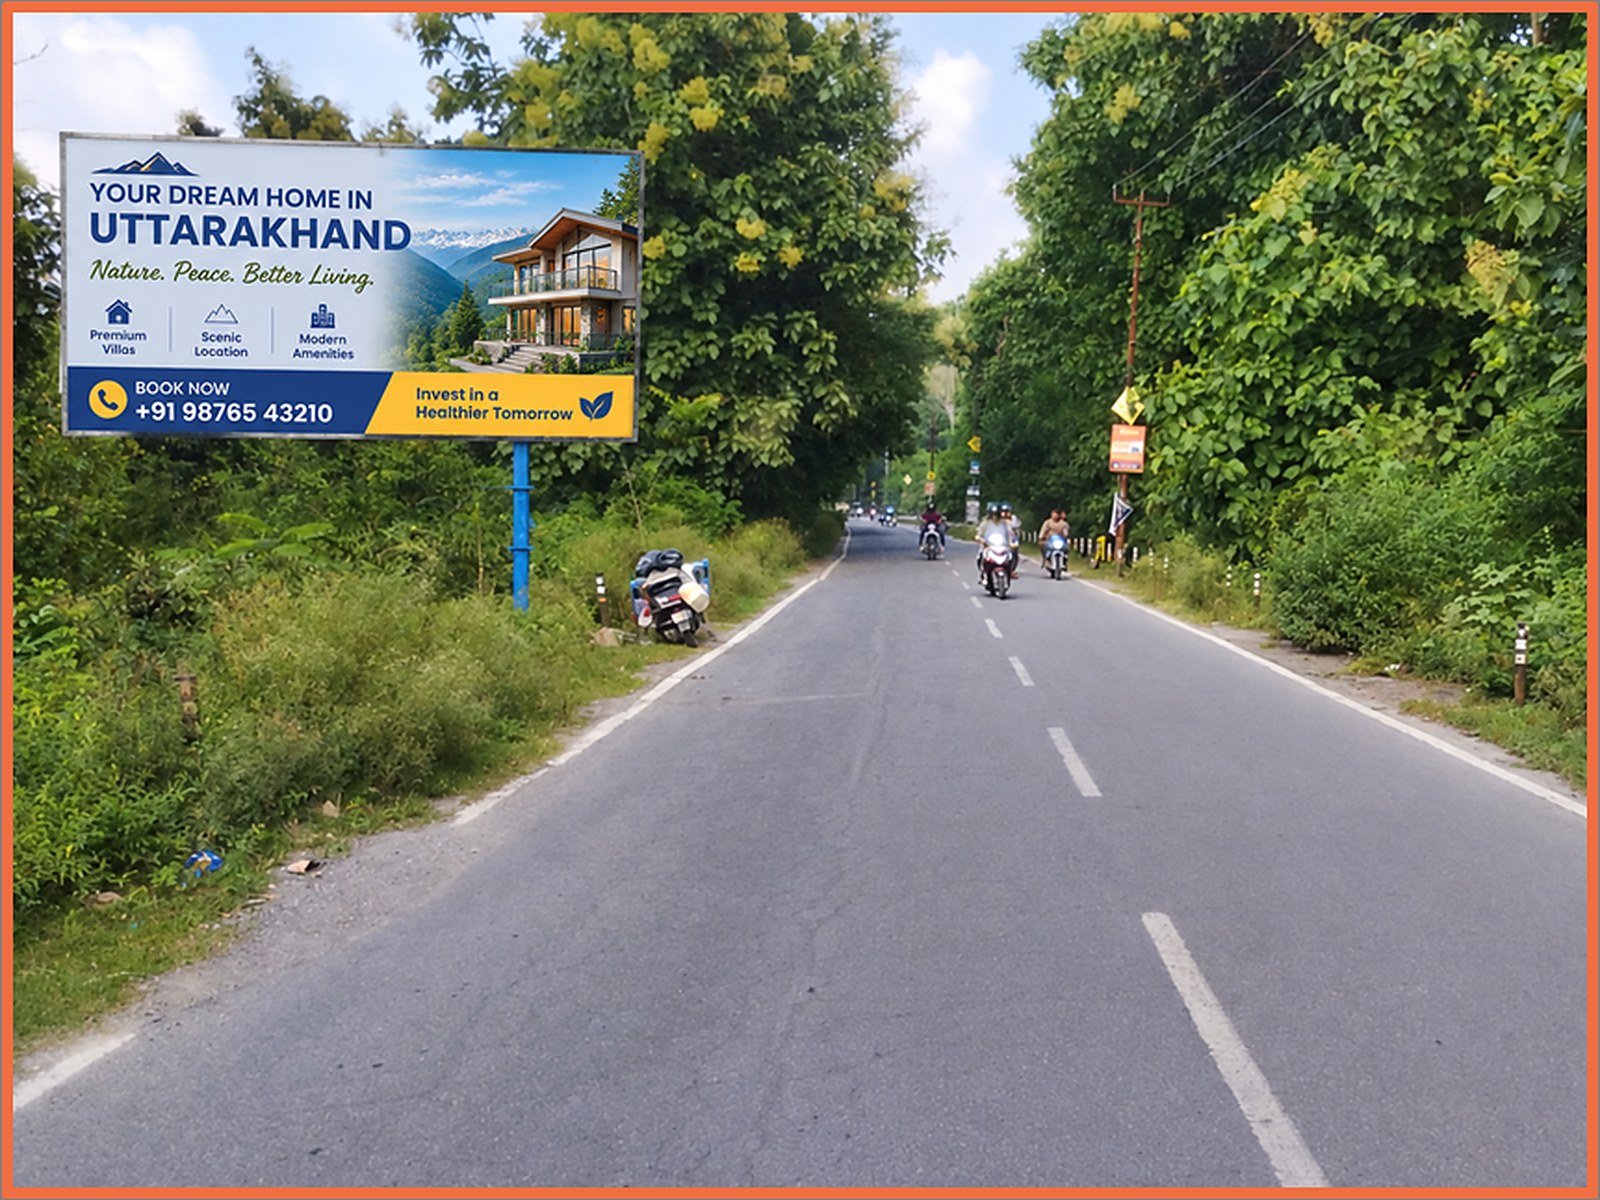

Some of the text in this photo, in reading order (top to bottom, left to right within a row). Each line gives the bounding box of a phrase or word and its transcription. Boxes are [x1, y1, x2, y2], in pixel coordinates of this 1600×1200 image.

[90, 183, 373, 210] YOUR DREAM HOME IN
[90, 212, 412, 250] UTTARAKHAND
[90, 259, 375, 294] Nature. Peace. Better Living.
[90, 329, 147, 342] Premium
[201, 331, 242, 344] Scenic
[299, 333, 347, 345] Modern
[102, 344, 136, 356] Villas
[194, 346, 248, 358] Location
[292, 348, 355, 361] Amenities
[135, 381, 230, 396] BOOK NOW
[416, 387, 499, 402] Invest in a
[135, 402, 333, 423] +91 98765 43210
[416, 405, 573, 421] Healthier Tomorrow
